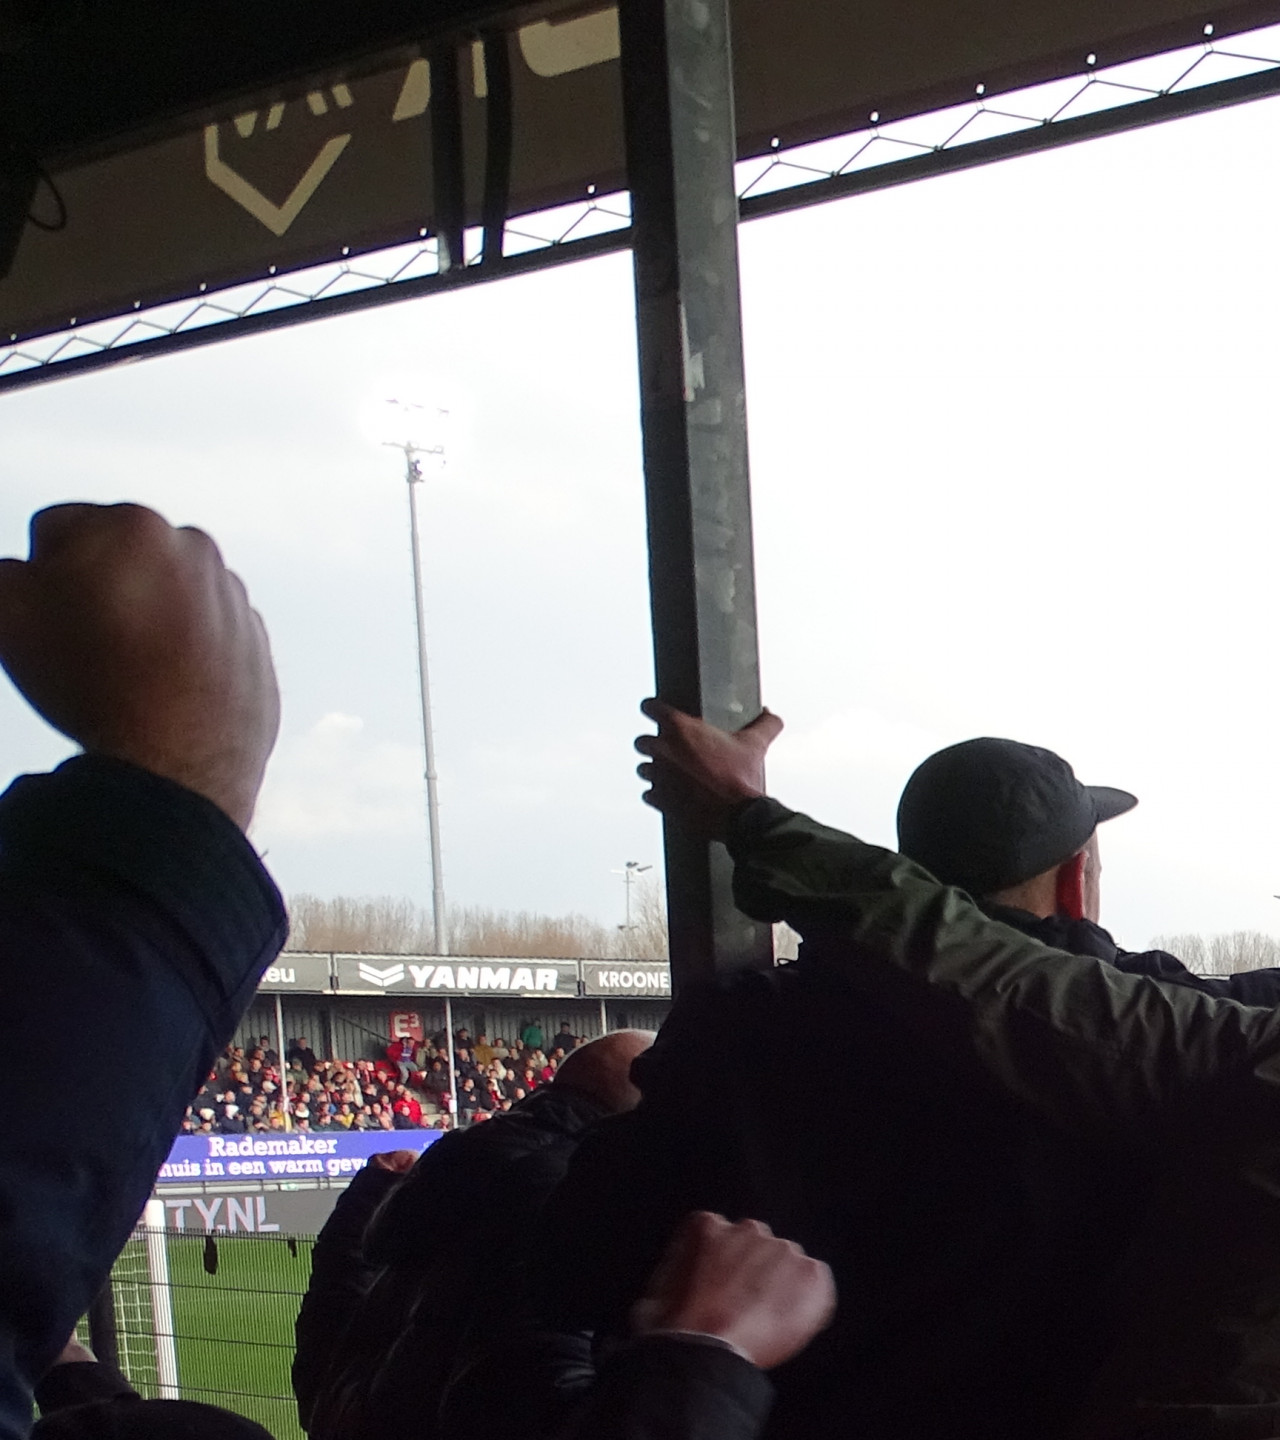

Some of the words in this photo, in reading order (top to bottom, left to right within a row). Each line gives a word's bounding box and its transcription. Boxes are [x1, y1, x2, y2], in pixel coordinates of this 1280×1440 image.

[408, 965, 559, 991] YANMAR
[208, 1135, 338, 1158] Rademaker
[205, 1158, 225, 1176] in
[228, 1159, 266, 1175] een
[267, 1158, 325, 1174] warm
